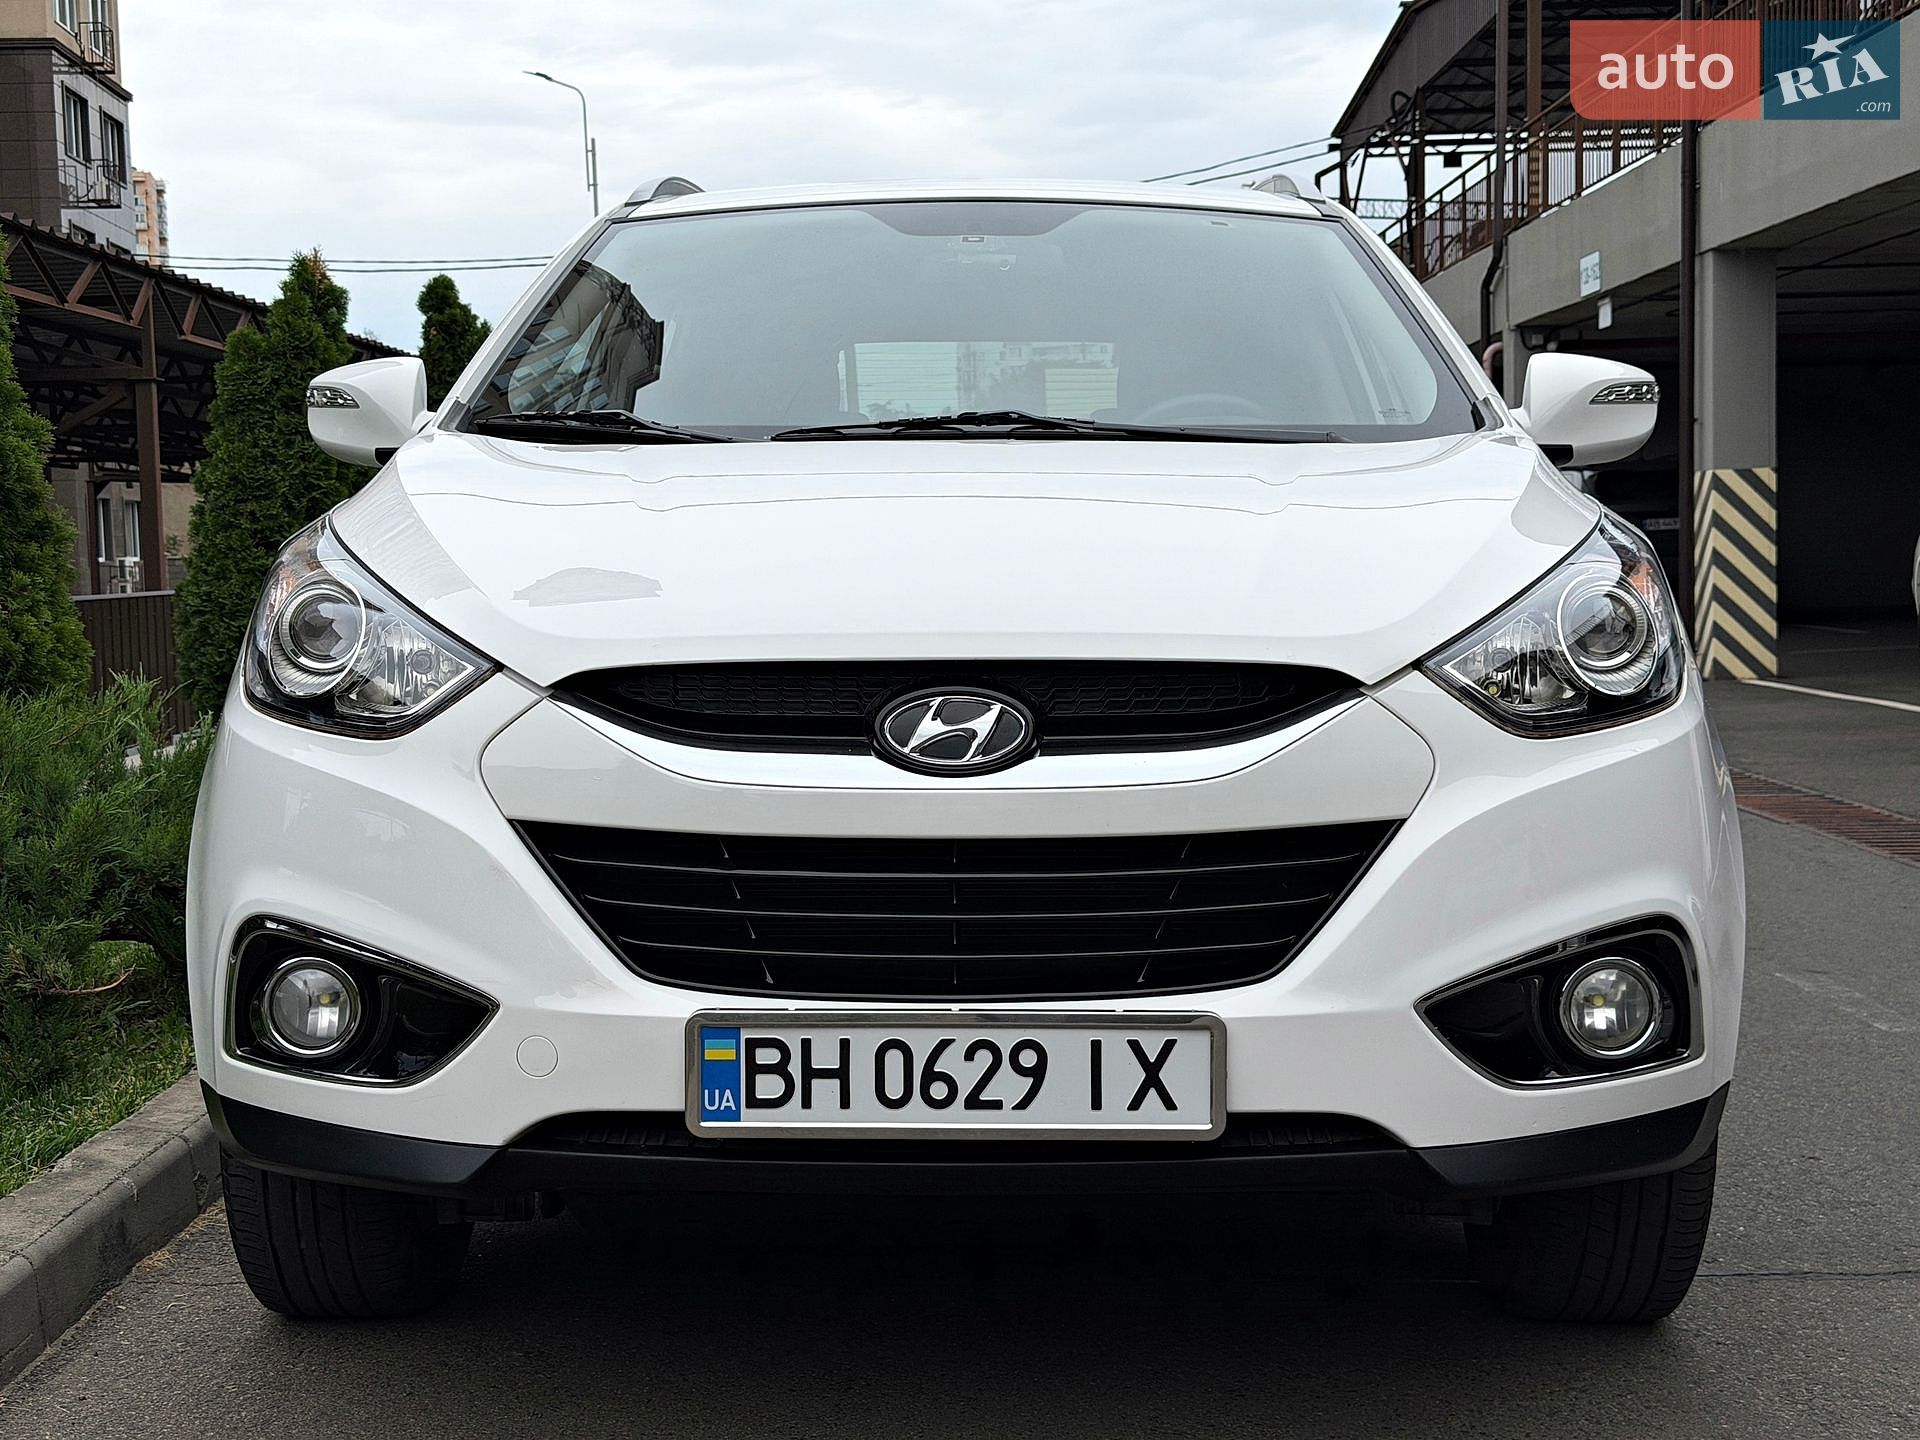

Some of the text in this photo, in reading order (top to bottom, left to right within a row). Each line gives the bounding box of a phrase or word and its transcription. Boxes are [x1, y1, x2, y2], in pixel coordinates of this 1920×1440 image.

[743, 1036, 1178, 1111] BH 0629 IX
[703, 1089, 737, 1112] UA
